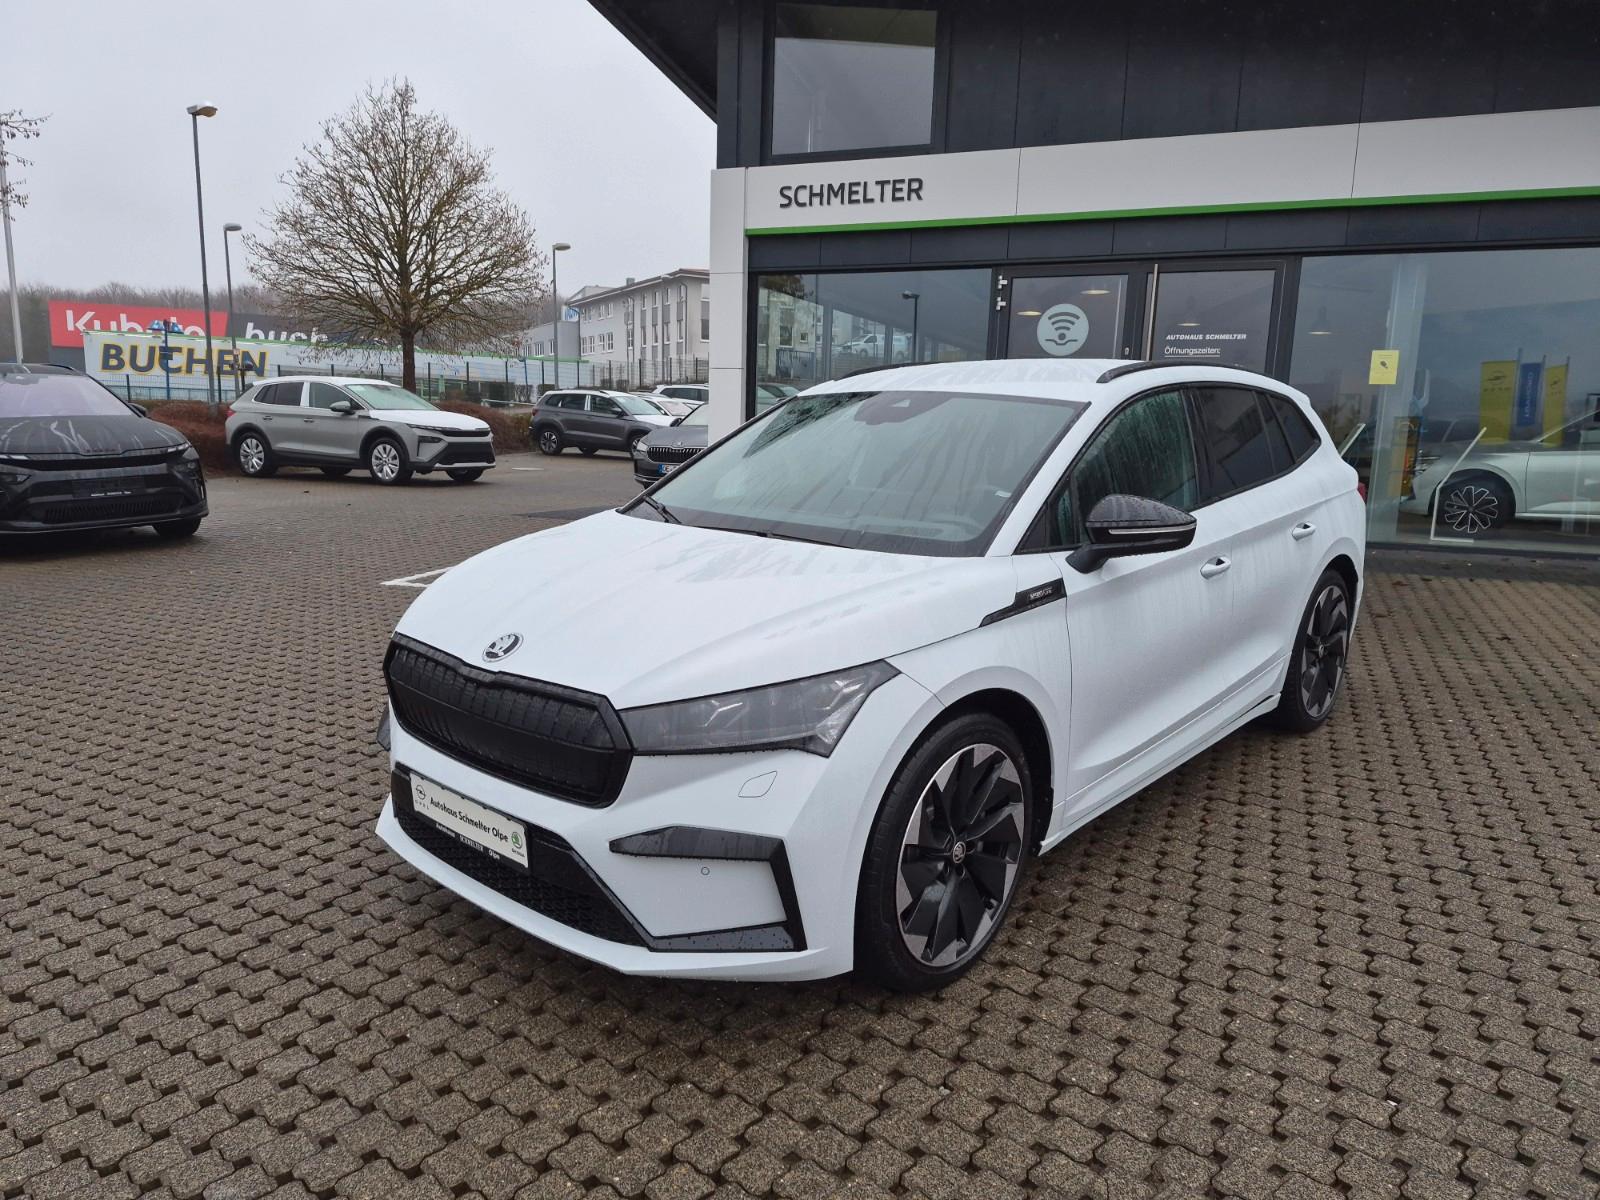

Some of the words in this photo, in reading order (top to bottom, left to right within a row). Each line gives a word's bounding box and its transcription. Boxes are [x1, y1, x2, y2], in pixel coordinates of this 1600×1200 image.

[779, 177, 923, 208] SCHMELTER
[65, 309, 206, 337] Kubo
[101, 343, 267, 377] BUCHEN
[430, 796, 458, 819] Autohaus
[458, 811, 491, 834] Schmelter
[491, 826, 509, 842] Olpe
